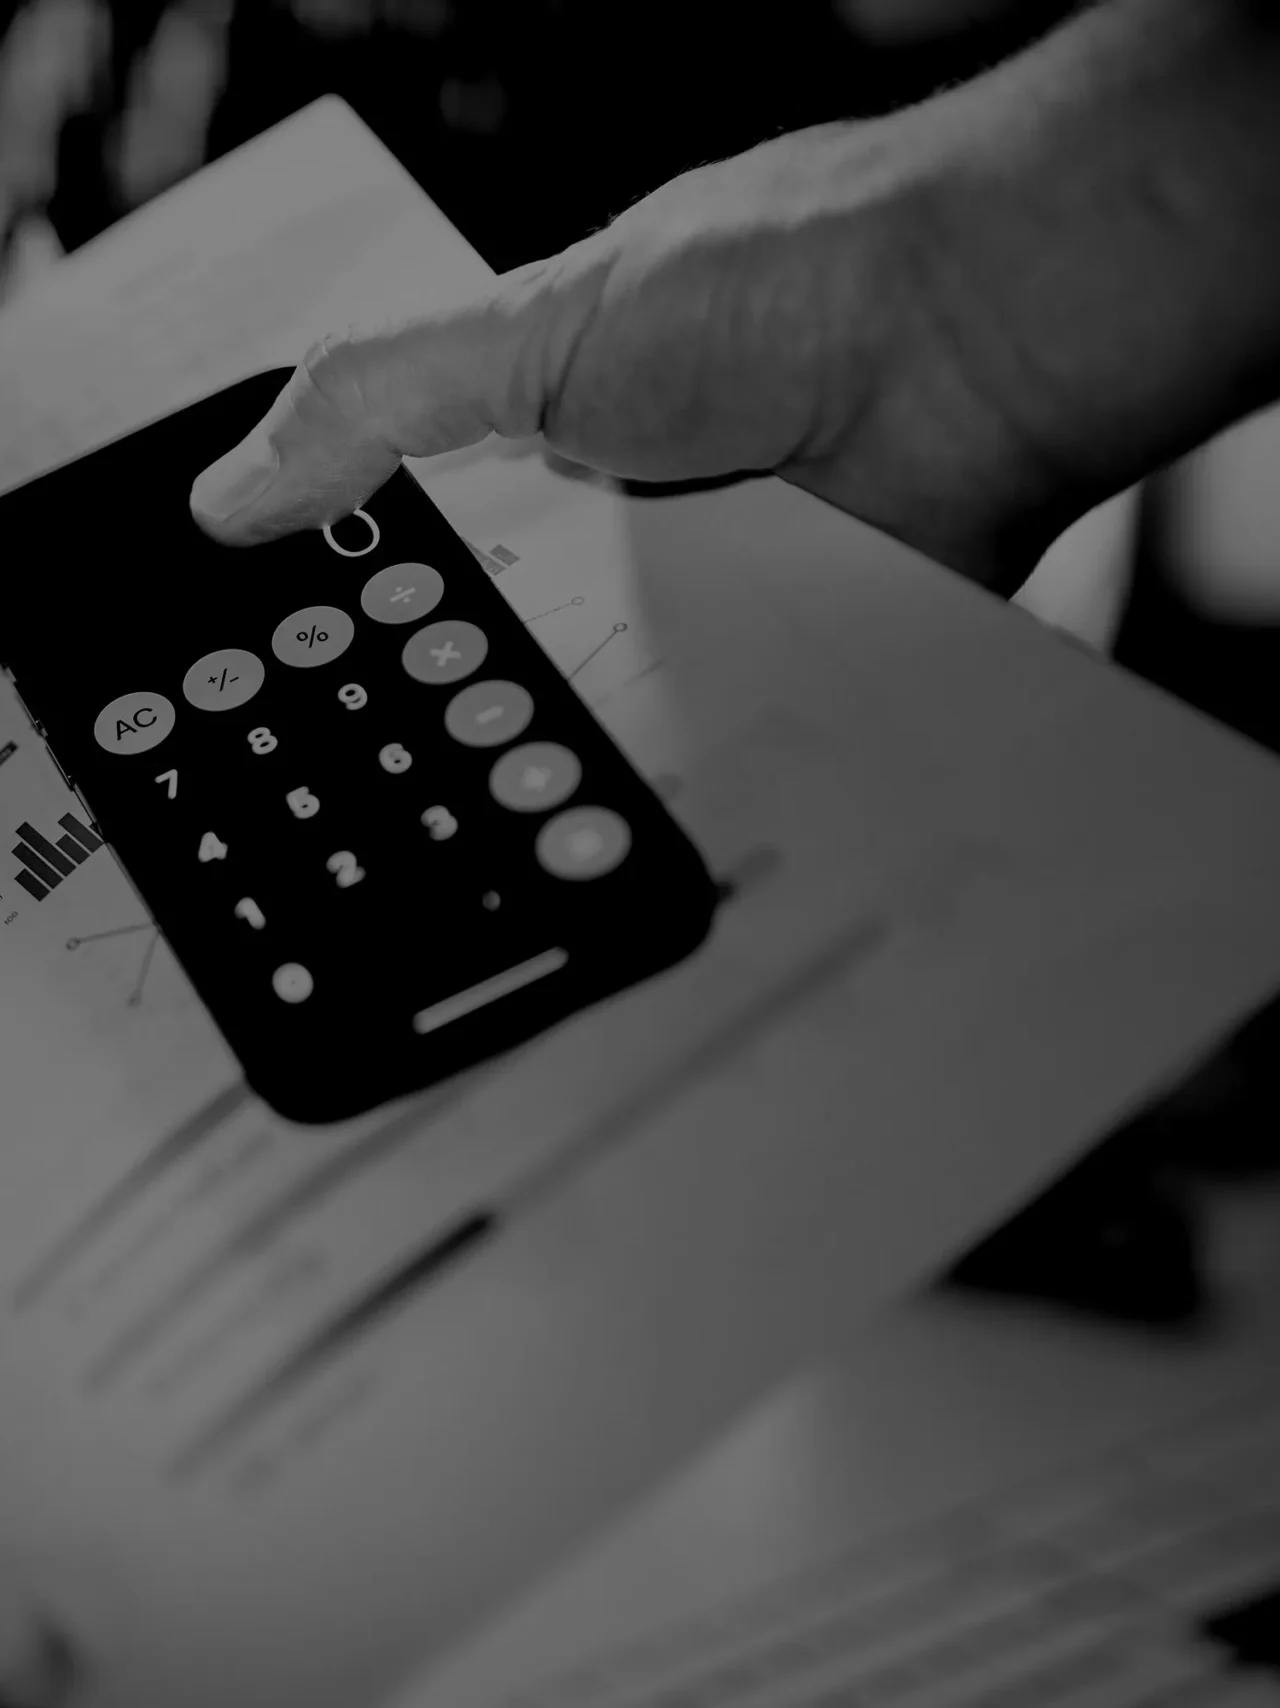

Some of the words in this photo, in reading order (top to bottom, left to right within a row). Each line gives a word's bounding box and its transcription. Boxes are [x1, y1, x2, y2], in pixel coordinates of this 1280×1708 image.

[114, 706, 158, 741] AC
[296, 624, 329, 649] %
[154, 768, 179, 800] 7
[247, 726, 278, 755] 8
[337, 683, 368, 711] 9
[198, 831, 228, 863] 4
[378, 742, 413, 774] 6
[326, 850, 366, 888] 2
[420, 804, 459, 842] 3
[3, 911, 19, 926] 100
